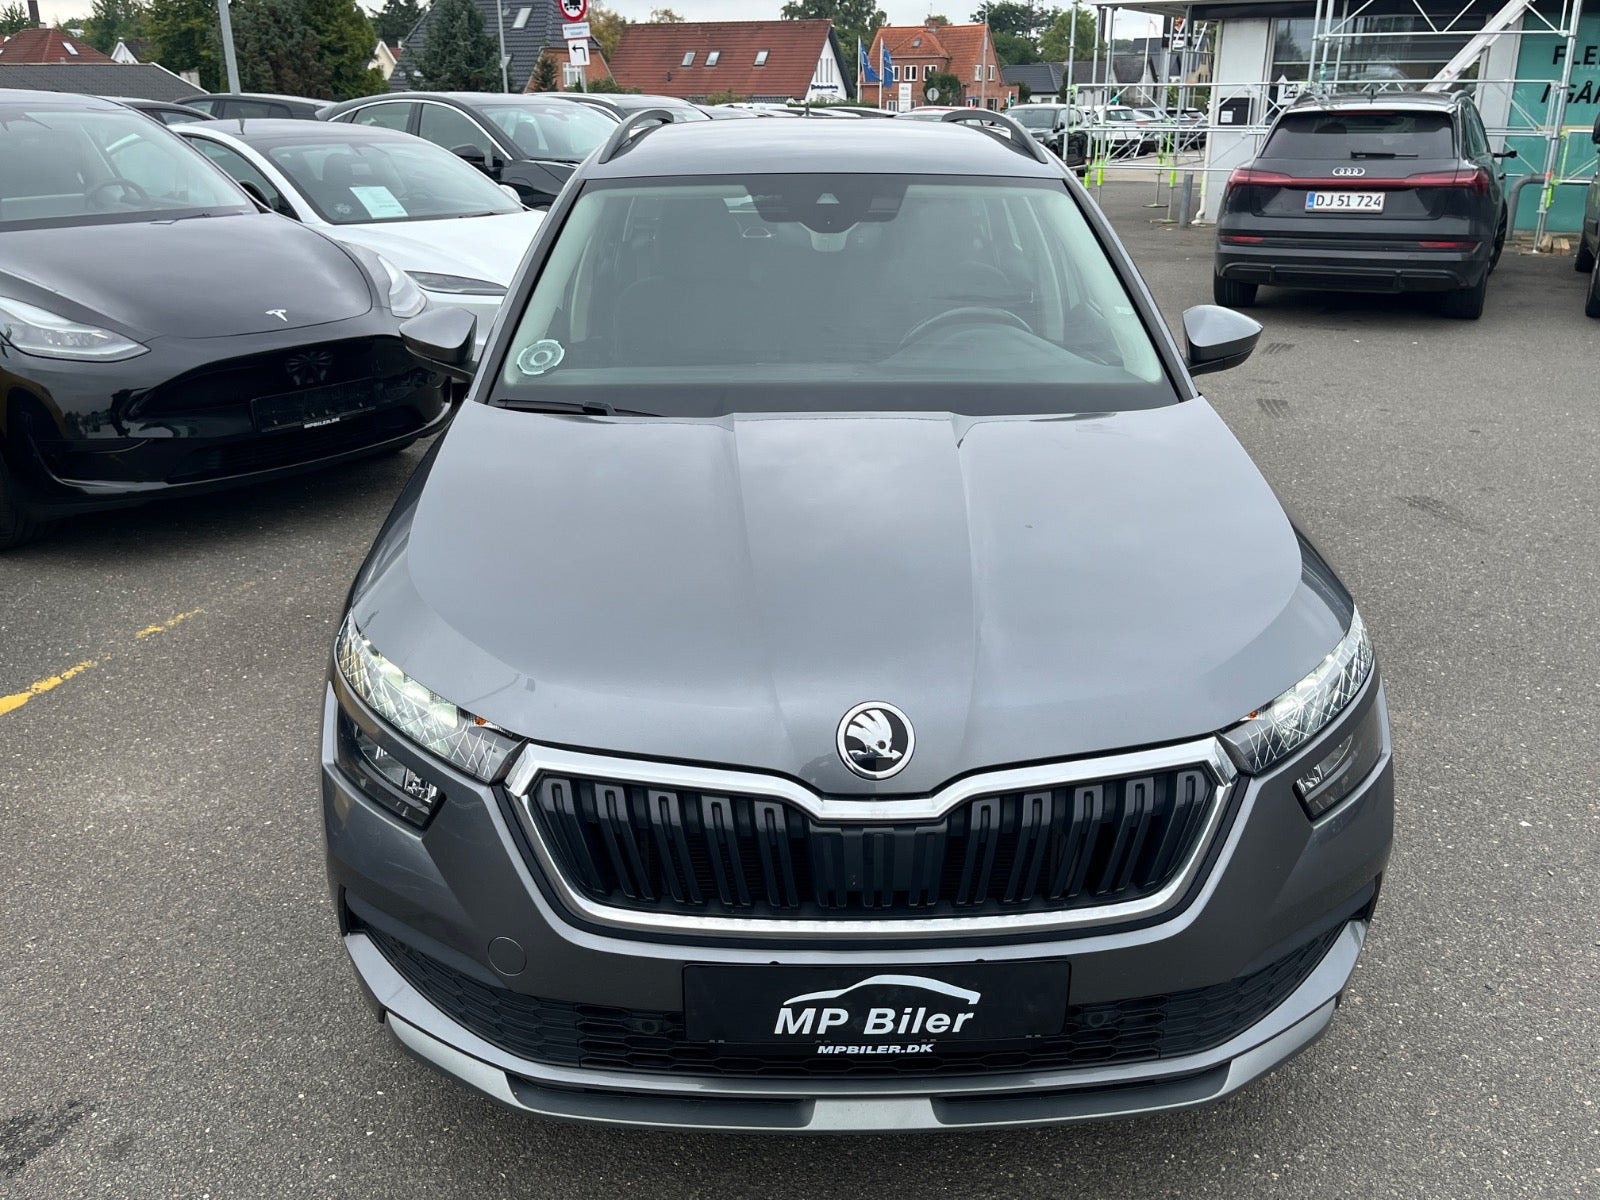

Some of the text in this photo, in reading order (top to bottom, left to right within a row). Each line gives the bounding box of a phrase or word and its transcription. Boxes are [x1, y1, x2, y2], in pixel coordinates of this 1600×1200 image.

[1552, 45, 1600, 65] FE
[1316, 194, 1334, 207] DJ
[1337, 195, 1351, 207] 51
[1357, 195, 1382, 207] 724
[774, 1006, 975, 1035] MP Biler
[817, 1043, 935, 1054] MPBILER.DK
